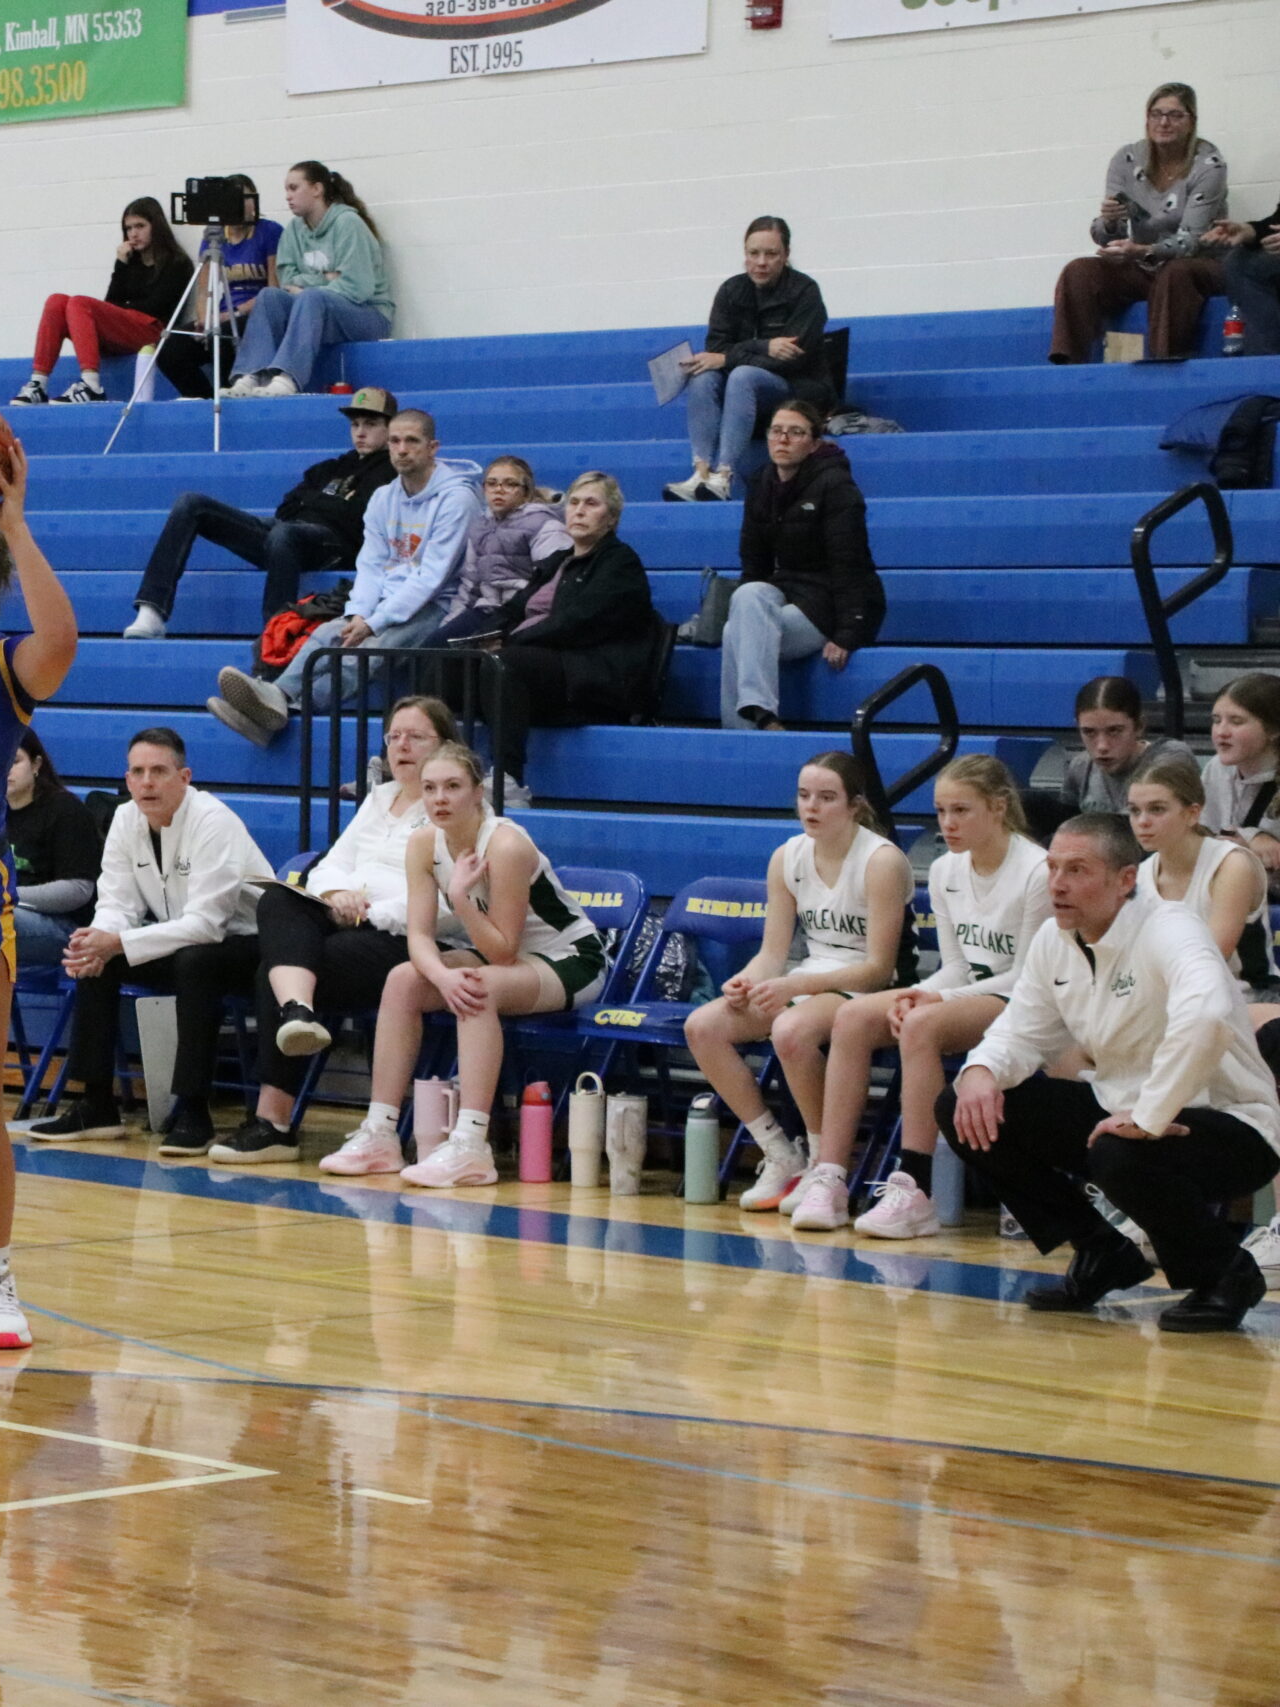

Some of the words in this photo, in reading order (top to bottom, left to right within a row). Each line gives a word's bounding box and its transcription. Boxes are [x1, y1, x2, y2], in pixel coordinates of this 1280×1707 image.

[4, 19, 61, 54] Kimball,
[64, 12, 90, 46] MN
[92, 8, 143, 43] 55353
[483, 39, 524, 70] 1995
[830, 910, 868, 937] LAKE
[955, 923, 980, 947] PLE
[980, 926, 1016, 955] LAKE
